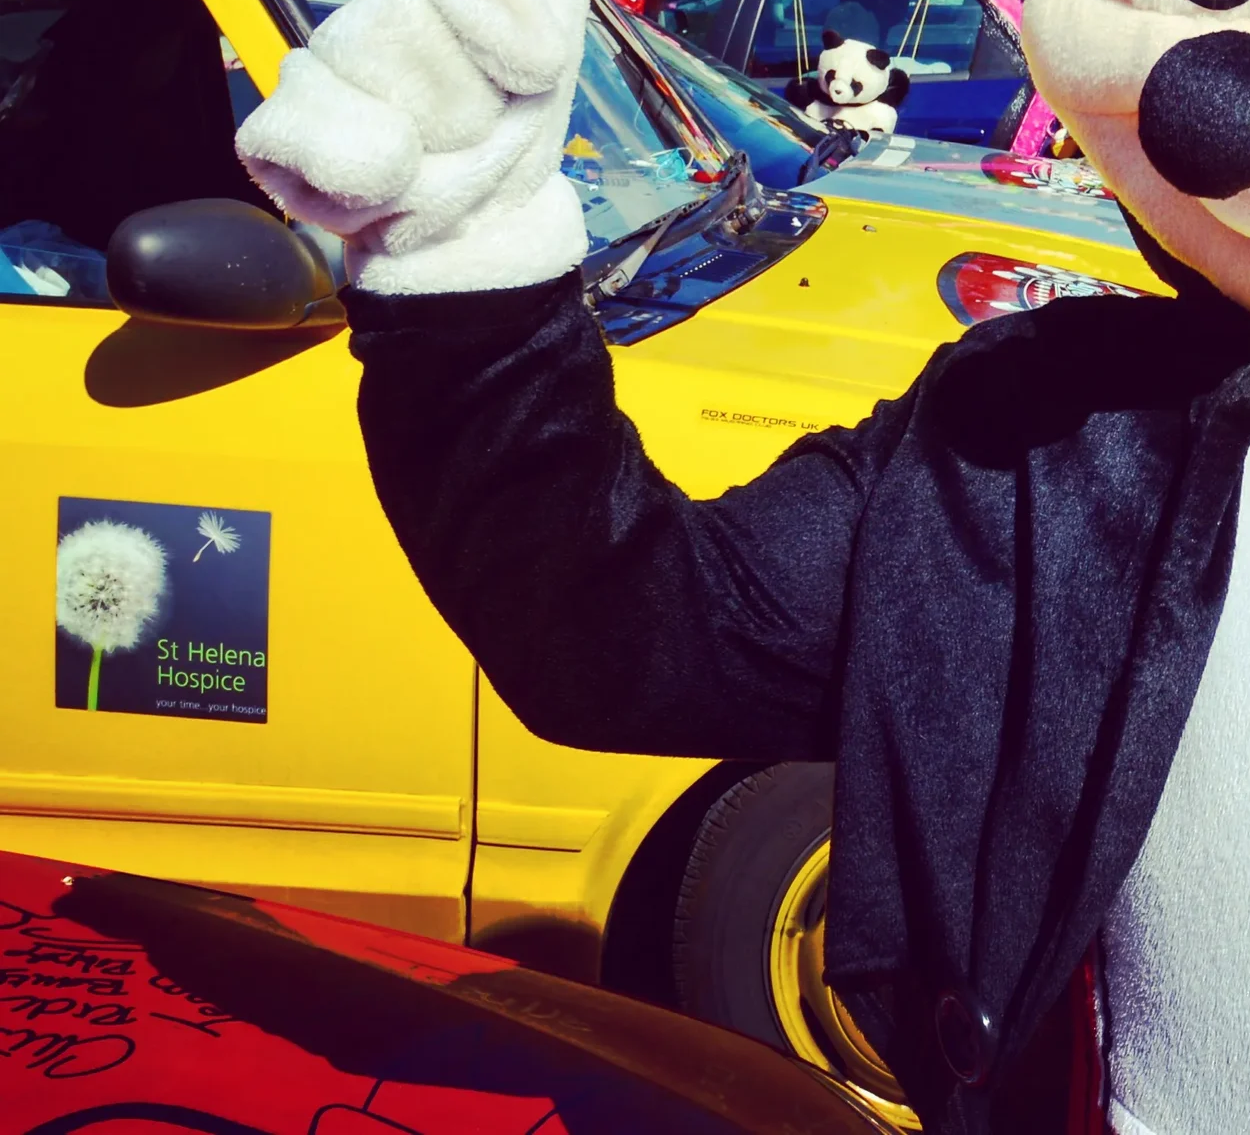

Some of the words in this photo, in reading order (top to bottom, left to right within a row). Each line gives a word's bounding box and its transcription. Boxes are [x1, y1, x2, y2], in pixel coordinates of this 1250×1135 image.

[701, 408, 728, 419] FOX
[731, 412, 797, 428] DOCTORS
[800, 421, 820, 431] UK
[157, 638, 179, 661] St
[188, 641, 266, 668] Helena
[157, 665, 246, 694] Hospice
[156, 698, 177, 709] your
[231, 702, 267, 716] hospice
